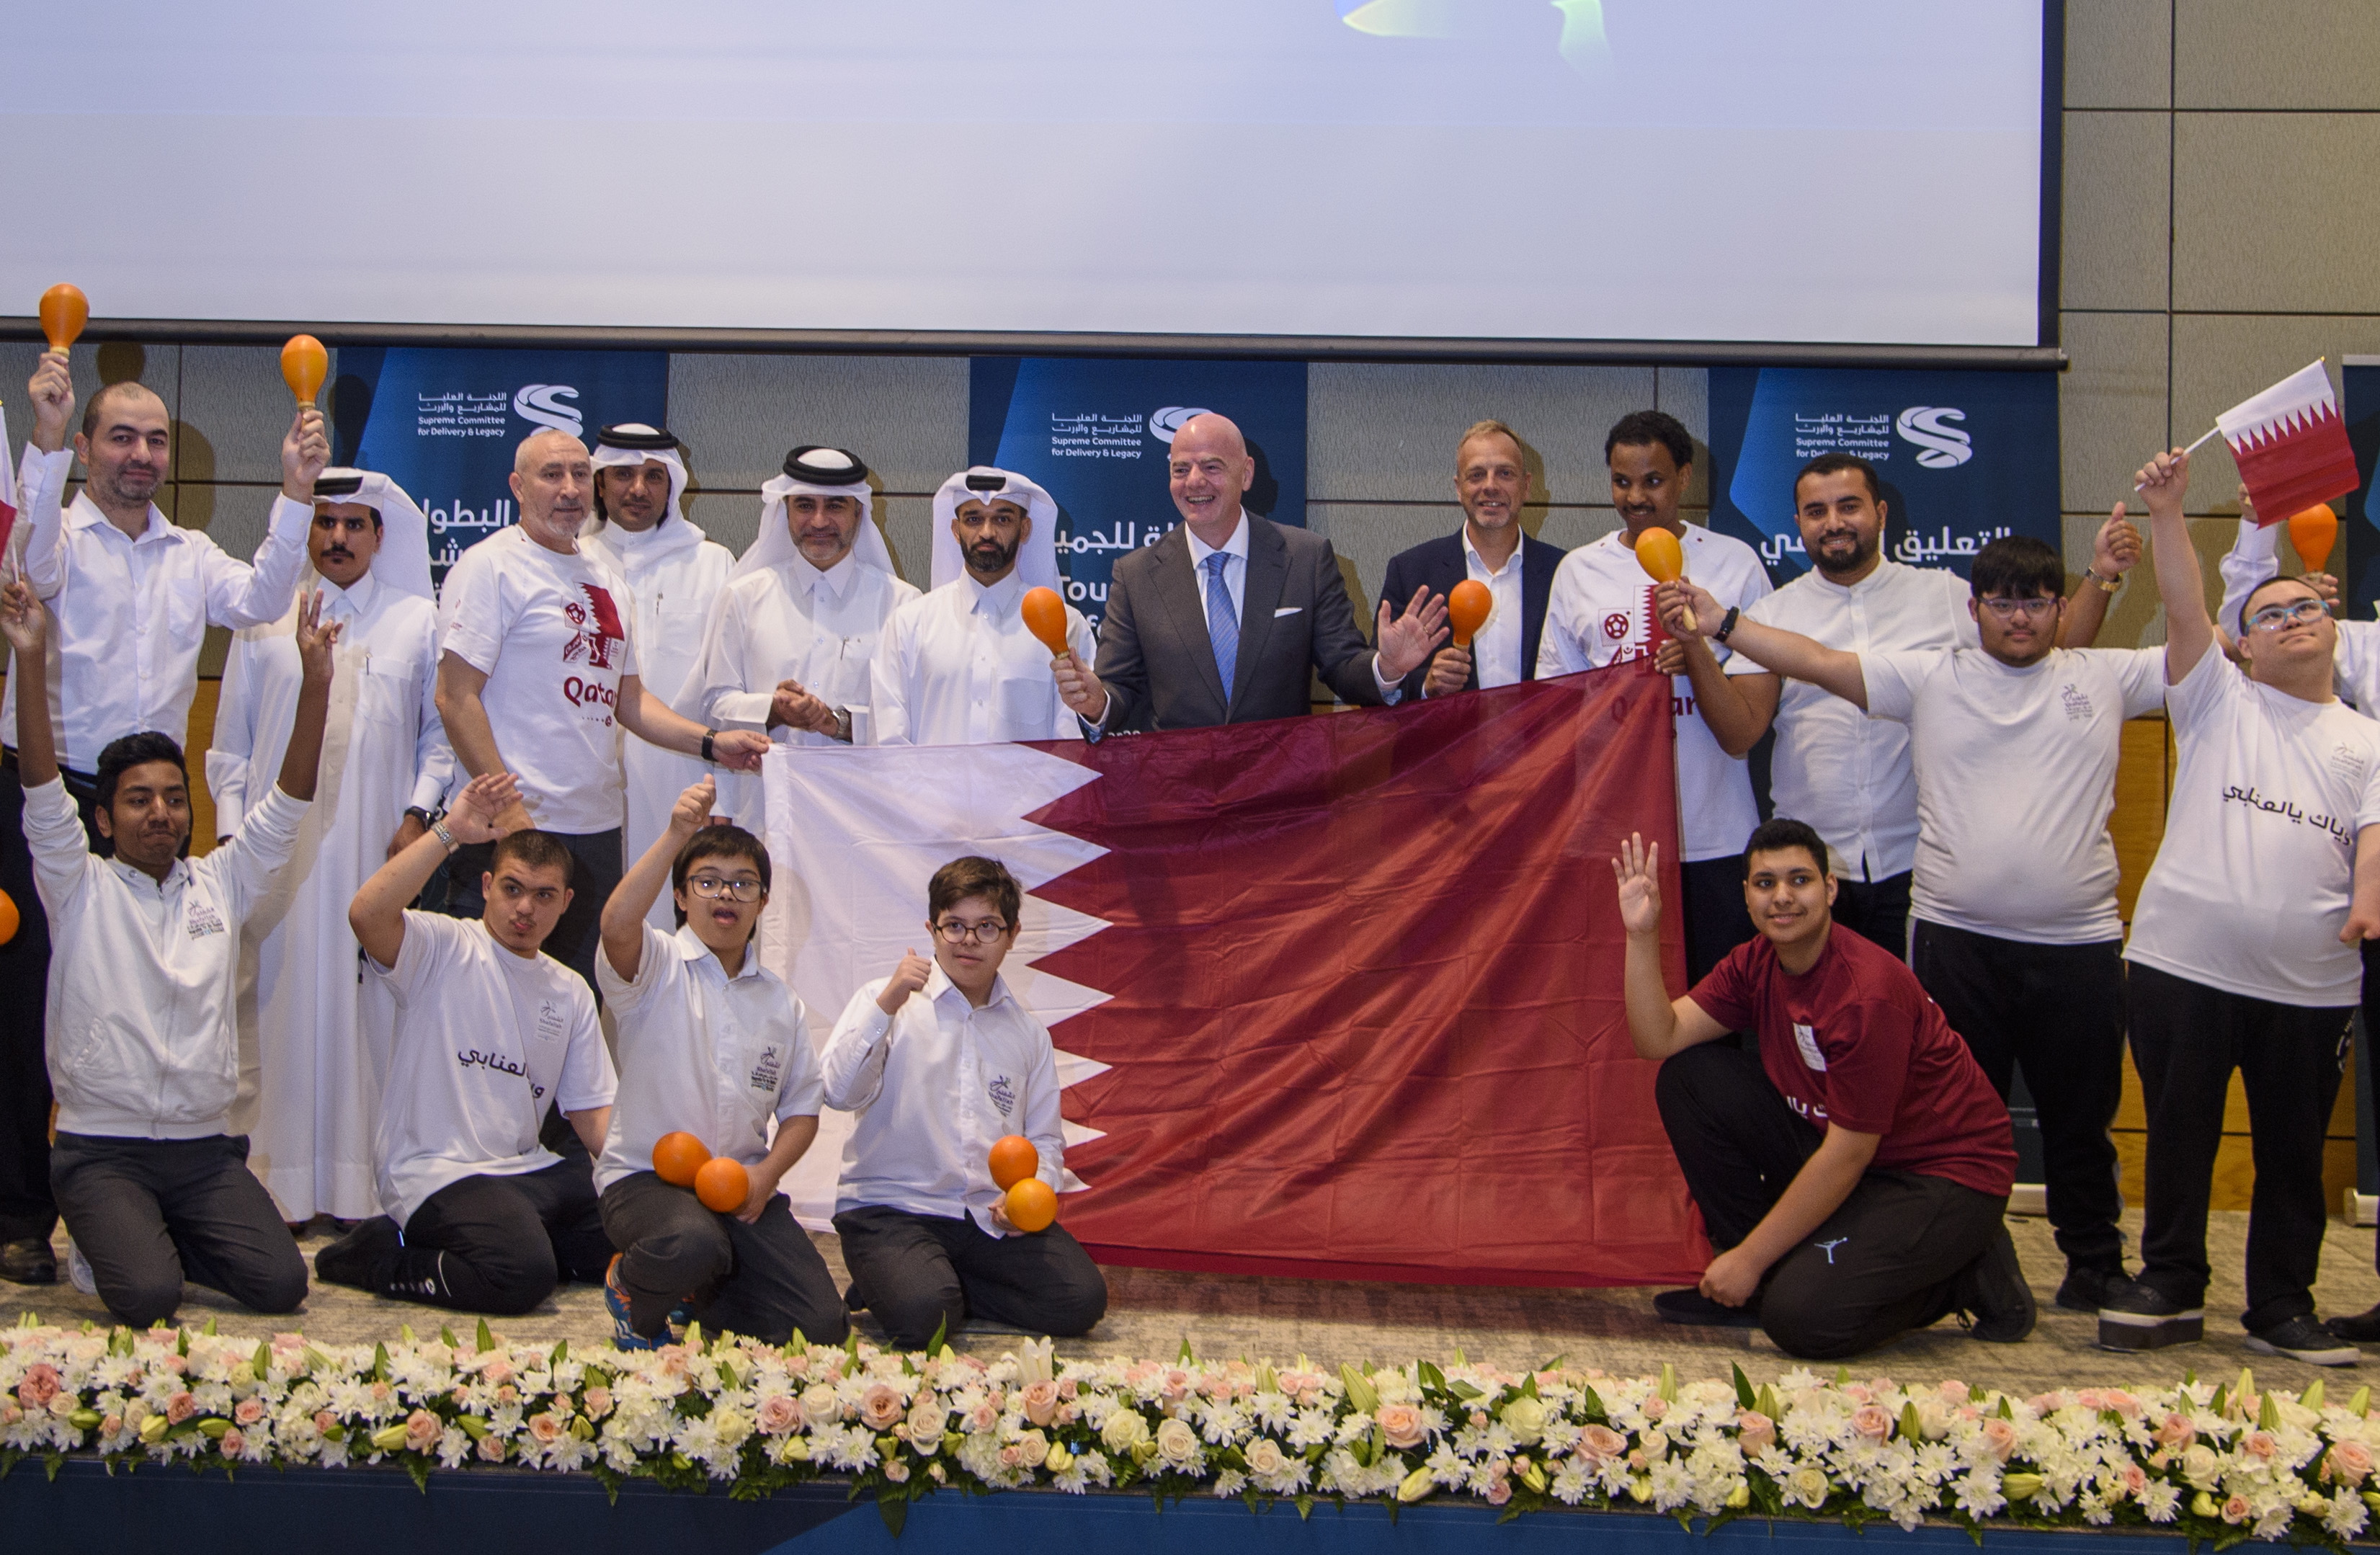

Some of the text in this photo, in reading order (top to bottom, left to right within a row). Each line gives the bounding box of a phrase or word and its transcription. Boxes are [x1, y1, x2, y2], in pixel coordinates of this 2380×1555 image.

[418, 416, 455, 425] Supreme
[431, 427, 466, 437] Delivery
[468, 427, 474, 436] &
[476, 428, 505, 437] Legacy
[1051, 436, 1141, 446] Supreme Committee
[1796, 437, 1889, 447] Supreme Committee
[1051, 447, 1141, 459] for Delivery & Legacy
[1796, 448, 1809, 458] for
[1858, 450, 1889, 460] Legacy
